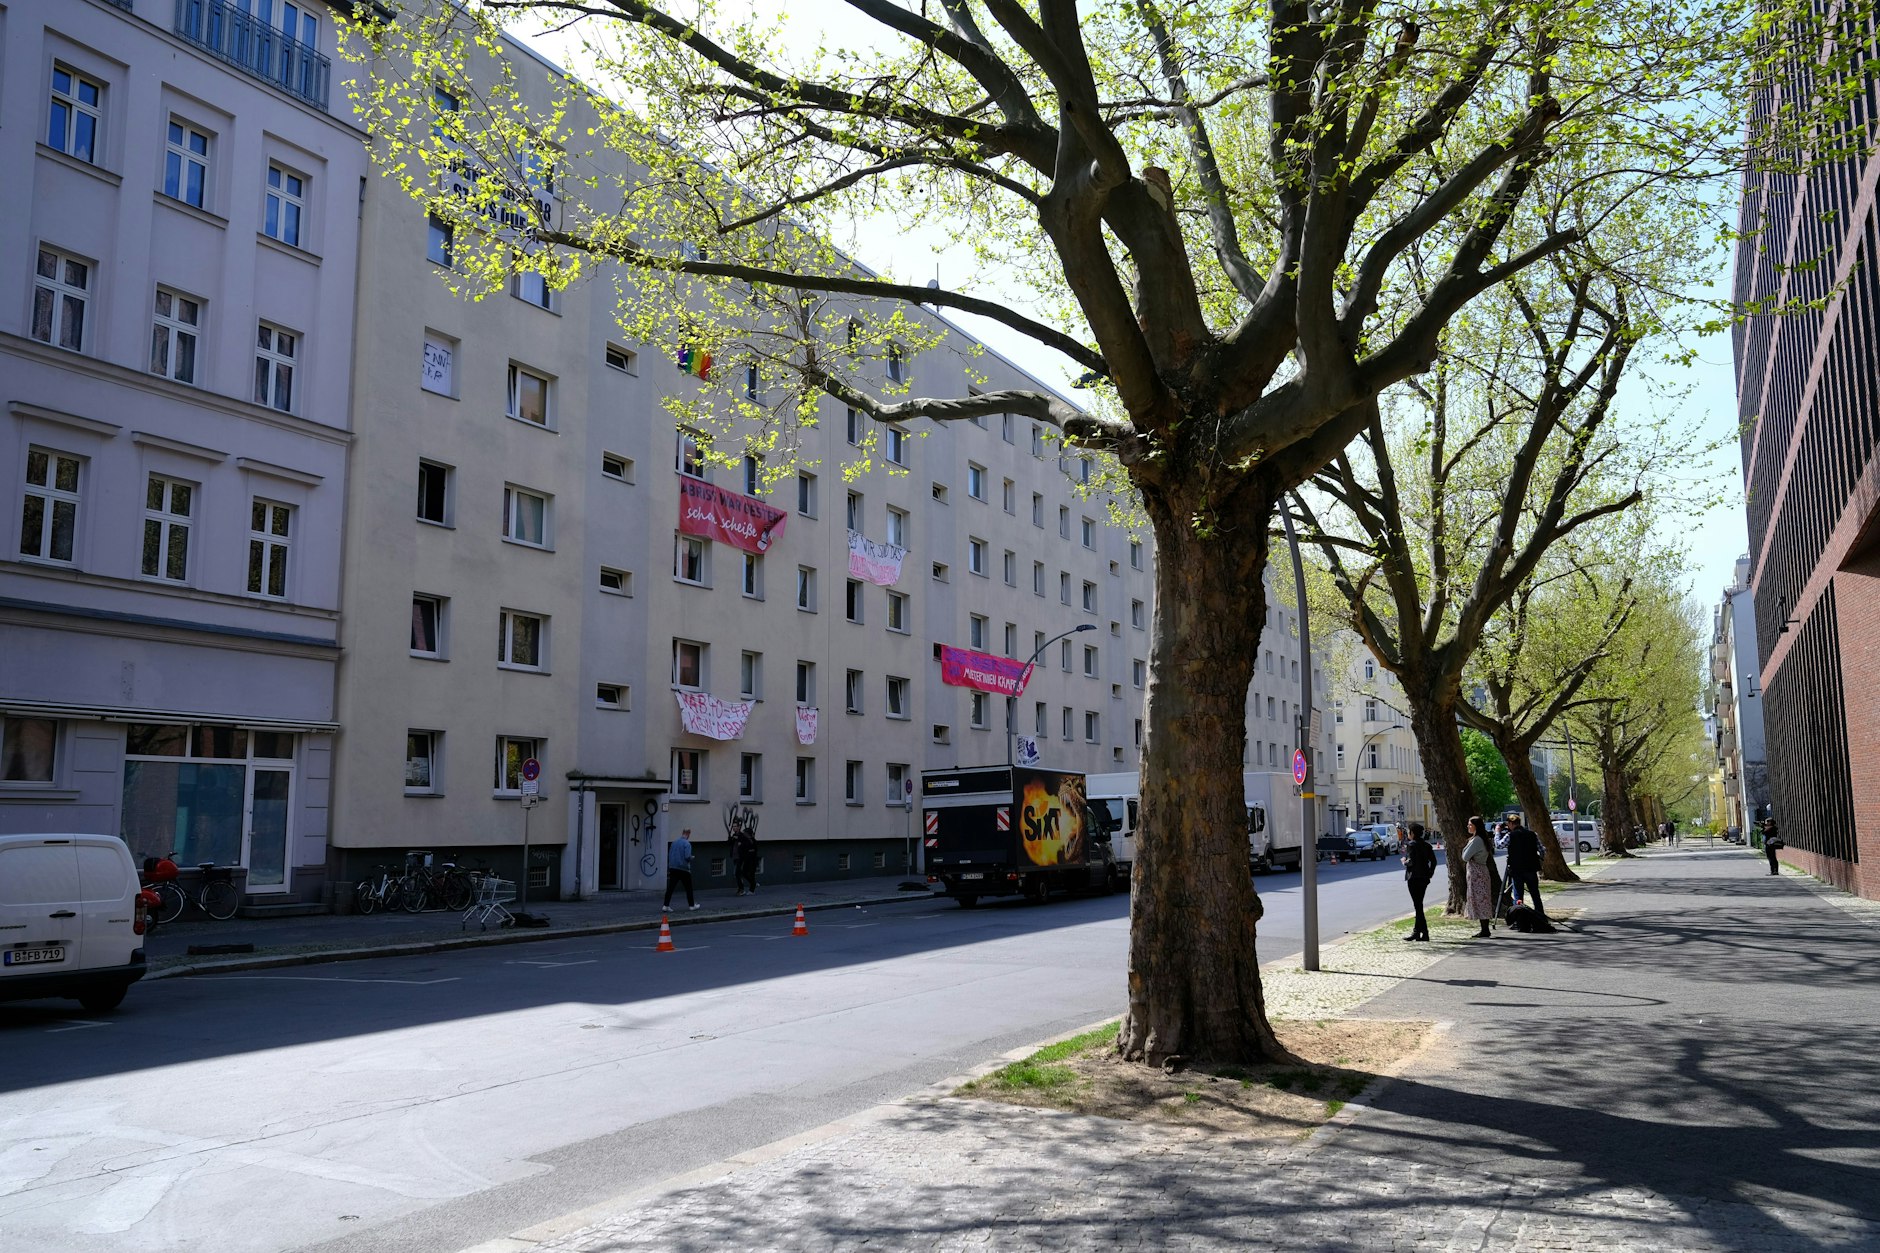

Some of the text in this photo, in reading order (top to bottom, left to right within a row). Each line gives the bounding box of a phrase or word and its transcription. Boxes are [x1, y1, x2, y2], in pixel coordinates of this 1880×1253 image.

[681, 484, 717, 502] ABRISS
[720, 493, 741, 512] WAR
[719, 517, 758, 539] scheiße
[15, 949, 60, 961] B FB 719
